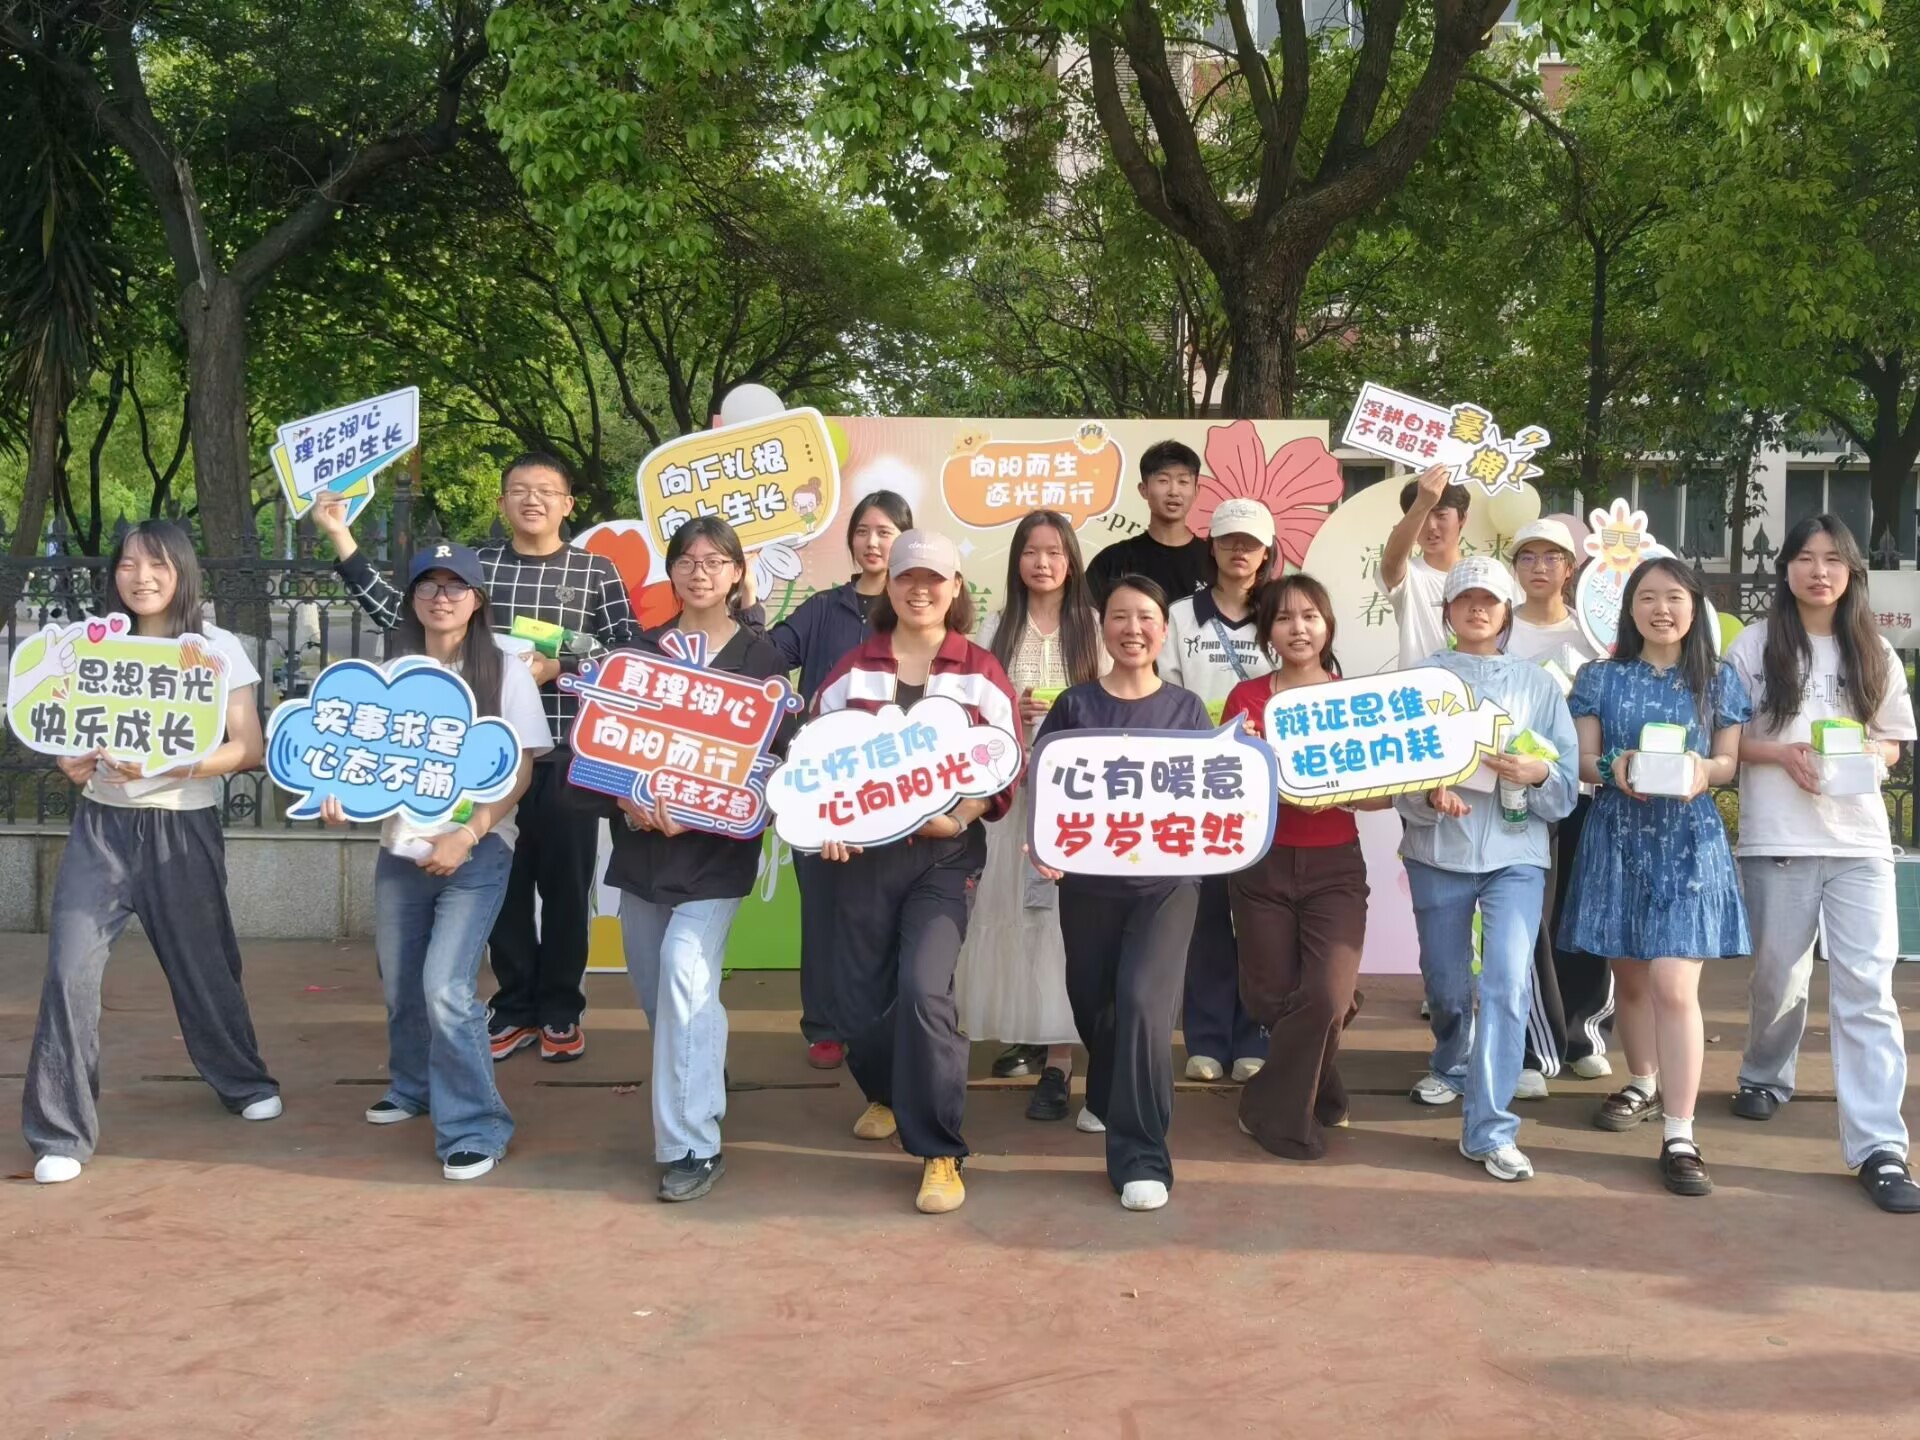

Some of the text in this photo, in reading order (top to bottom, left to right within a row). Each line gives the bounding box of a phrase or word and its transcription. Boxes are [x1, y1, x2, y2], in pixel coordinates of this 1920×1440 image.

[294, 404, 382, 464] 理论润心
[1355, 418, 1438, 458] 不负韶华
[1363, 400, 1446, 440] 深耕自我
[313, 422, 403, 483] 向阳生长
[657, 437, 789, 499] 向下扎根
[970, 452, 1078, 478] 向阳而生
[985, 481, 1095, 507] 逐光而行
[434, 545, 453, 558] R
[1200, 640, 1258, 651] FIND EAUTY
[77, 658, 215, 703] 思想有光
[618, 658, 757, 729] 真理润心
[30, 702, 196, 756] 快乐成长
[312, 696, 468, 758] 实事求是
[1273, 686, 1426, 740] 辩证思维
[302, 742, 456, 800] 心态不崩
[592, 715, 738, 782] 向阳而行
[784, 721, 938, 793] 心怀信仰
[1291, 724, 1445, 778] 拒绝内耗
[655, 771, 752, 819] 笃志不怠
[818, 752, 975, 827] 心向阳光
[1051, 754, 1245, 801] 心有暖意
[1054, 811, 1245, 858] 岁岁安然
